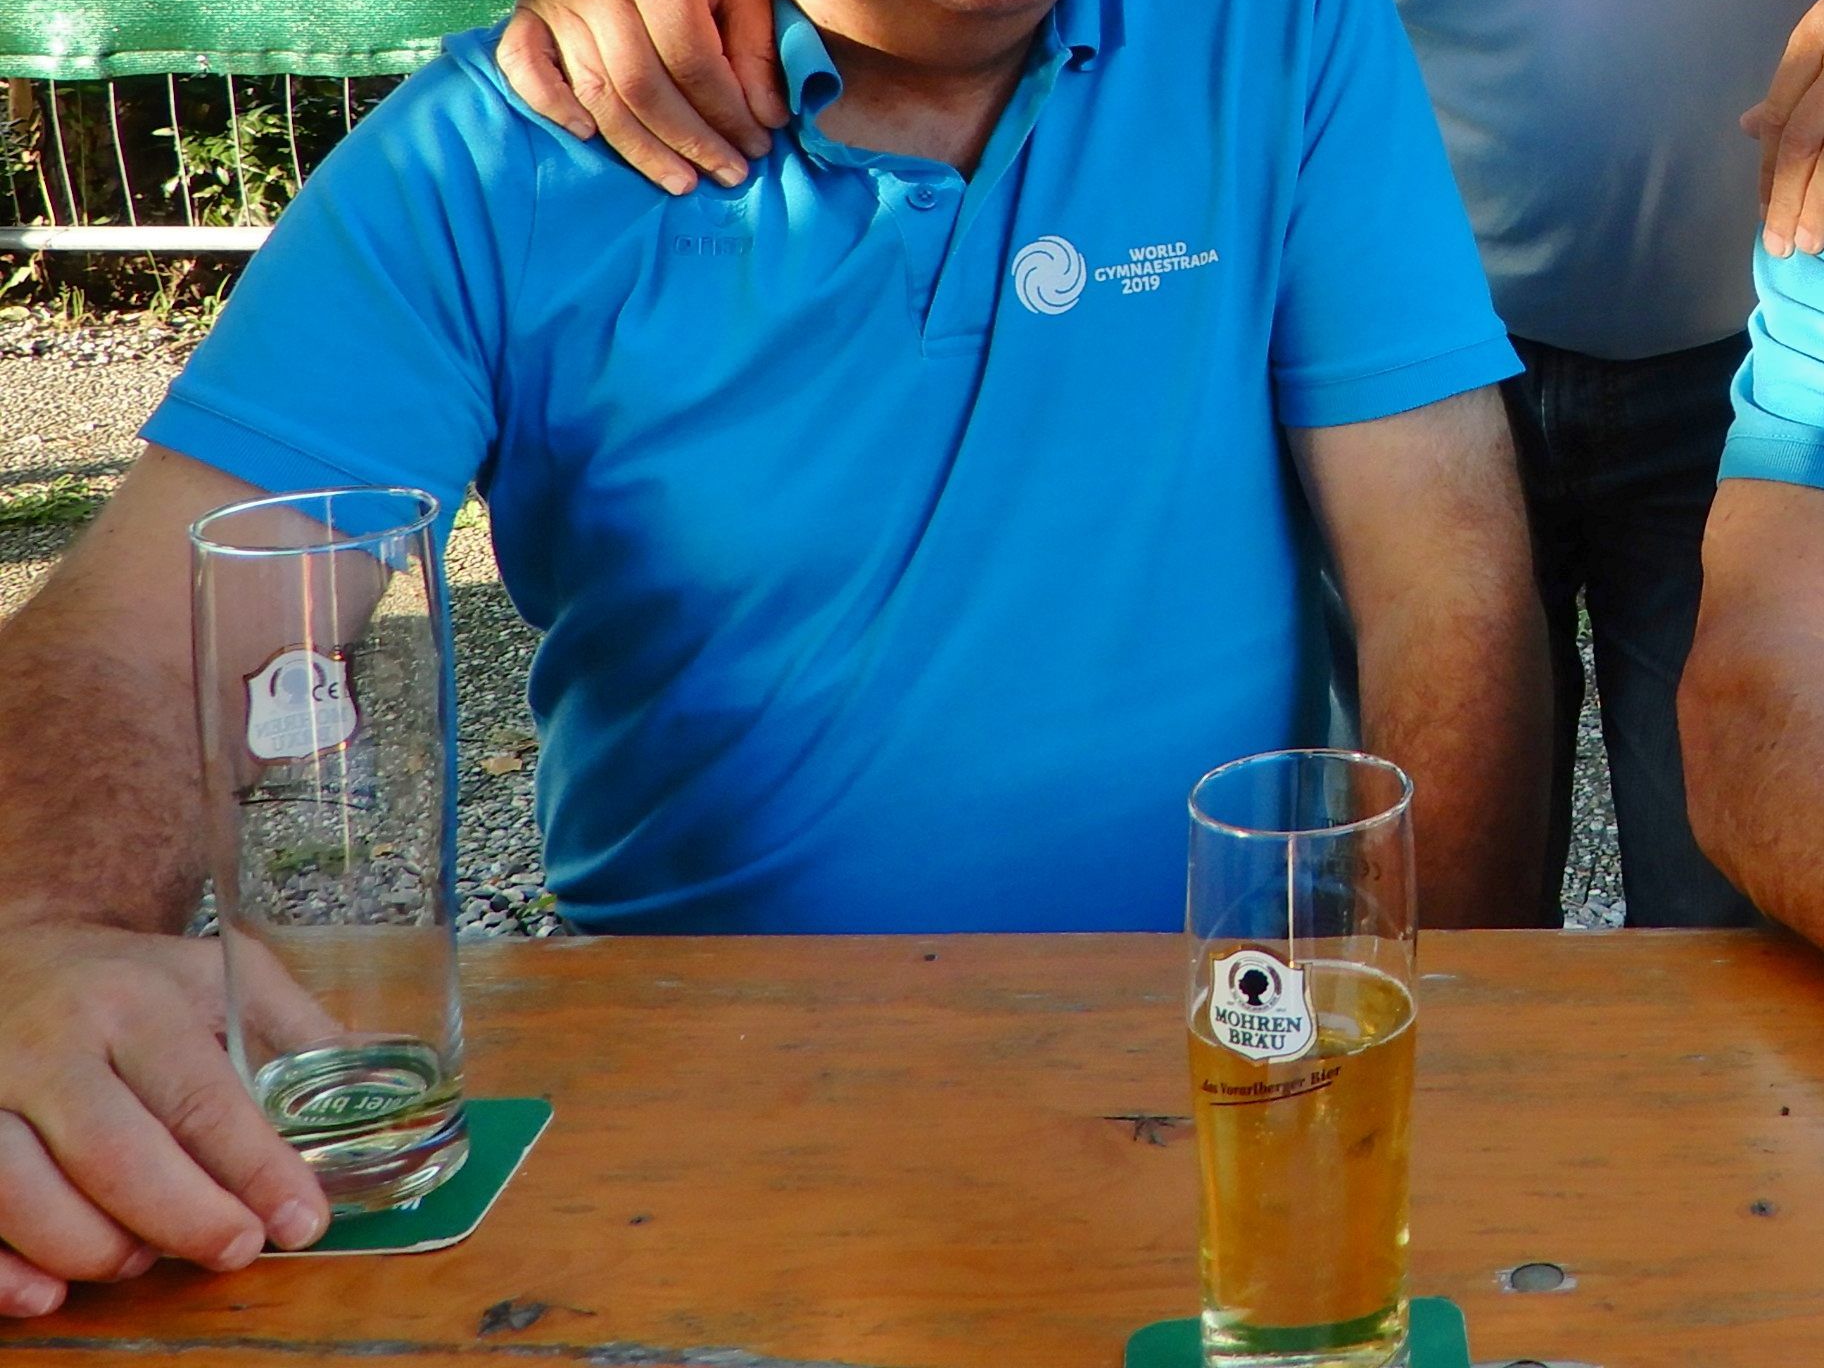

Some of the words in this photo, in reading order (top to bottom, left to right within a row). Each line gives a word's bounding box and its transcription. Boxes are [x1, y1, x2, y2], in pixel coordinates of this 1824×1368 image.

[1129, 242, 1187, 262] WORLD
[1094, 249, 1219, 282] GYMNAESTRADA
[1121, 275, 1161, 294] 2019
[1215, 1006, 1302, 1033] MOHREN
[1228, 1028, 1286, 1050] BRÄU
